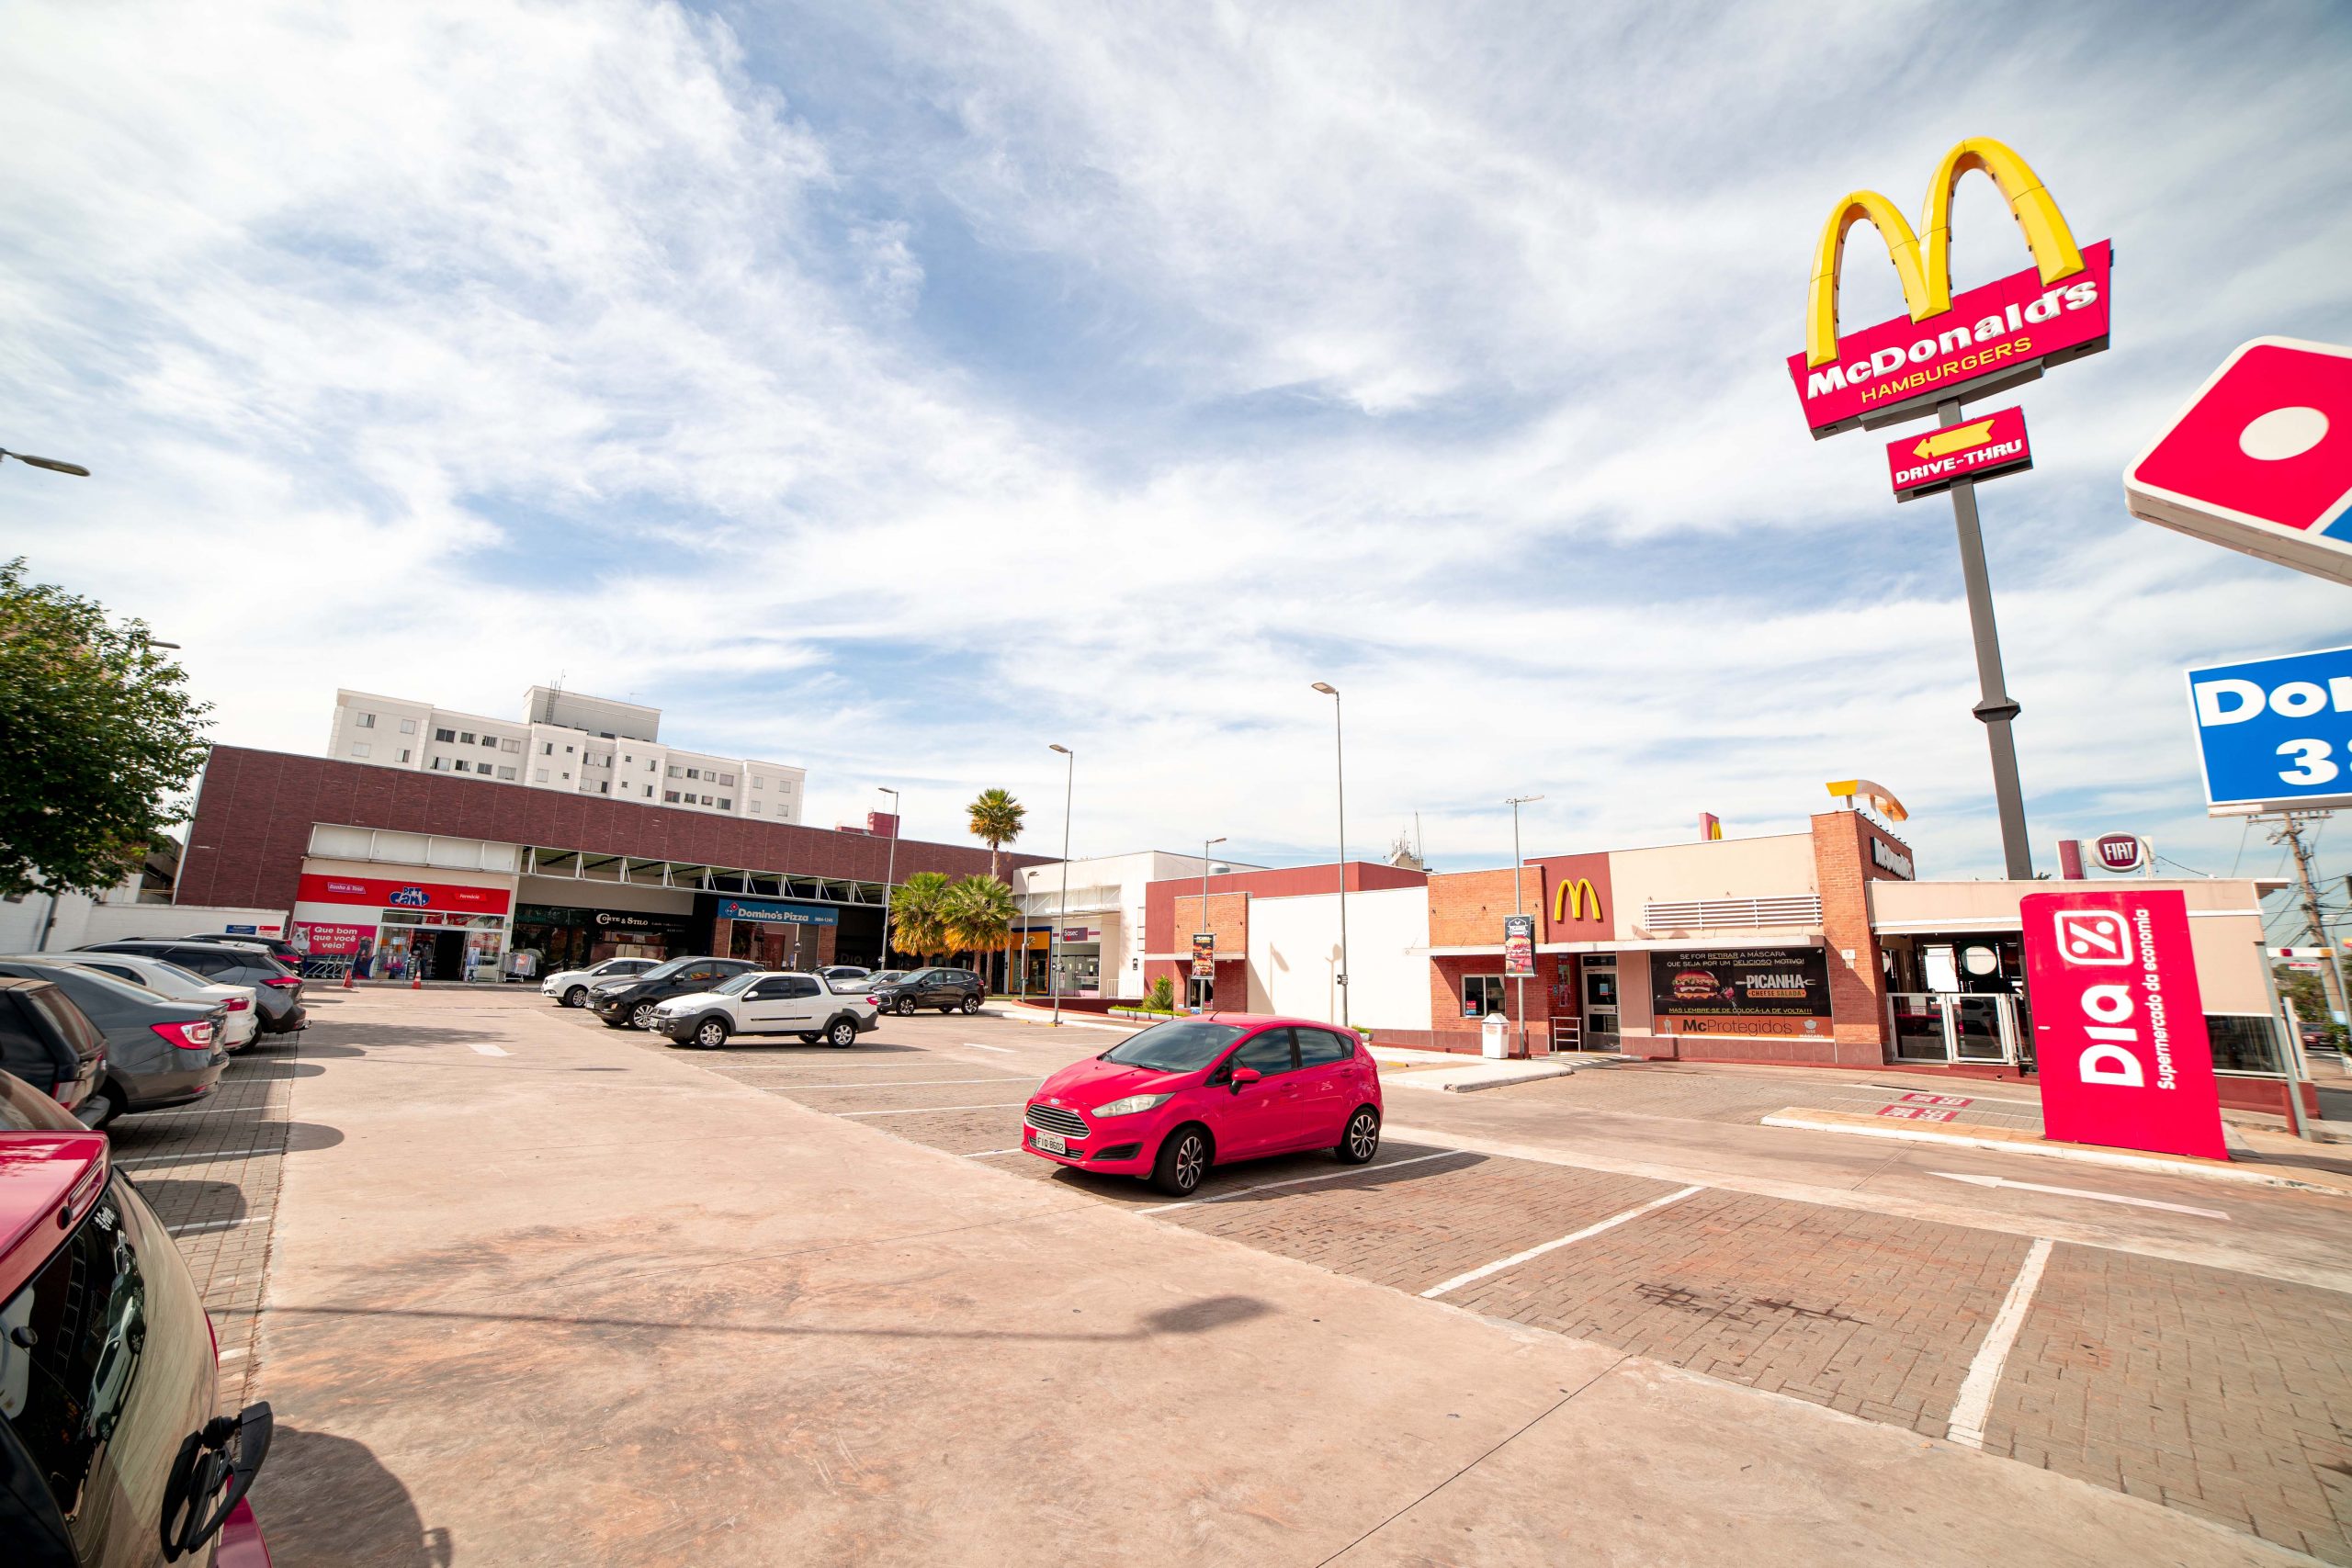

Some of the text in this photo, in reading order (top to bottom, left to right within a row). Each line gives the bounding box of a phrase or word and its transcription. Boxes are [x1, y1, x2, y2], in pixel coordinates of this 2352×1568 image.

[1807, 280, 2098, 400] McDonald's
[1861, 336, 2032, 403] HAMBURGERS
[1895, 438, 2022, 484] DRIVE-THRU
[2275, 738, 2352, 786] 3
[2103, 841, 2134, 861] FIAT
[403, 886, 423, 895] PET
[627, 917, 649, 926] STILO
[738, 908, 783, 920] Domino's
[784, 911, 809, 922] Pizza
[314, 926, 357, 935] Que bom
[334, 934, 356, 942] você
[1746, 974, 1805, 989] PICANHA
[2132, 908, 2178, 1090] Supermercado da economia
[1682, 1020, 1792, 1037] McProtegidos
